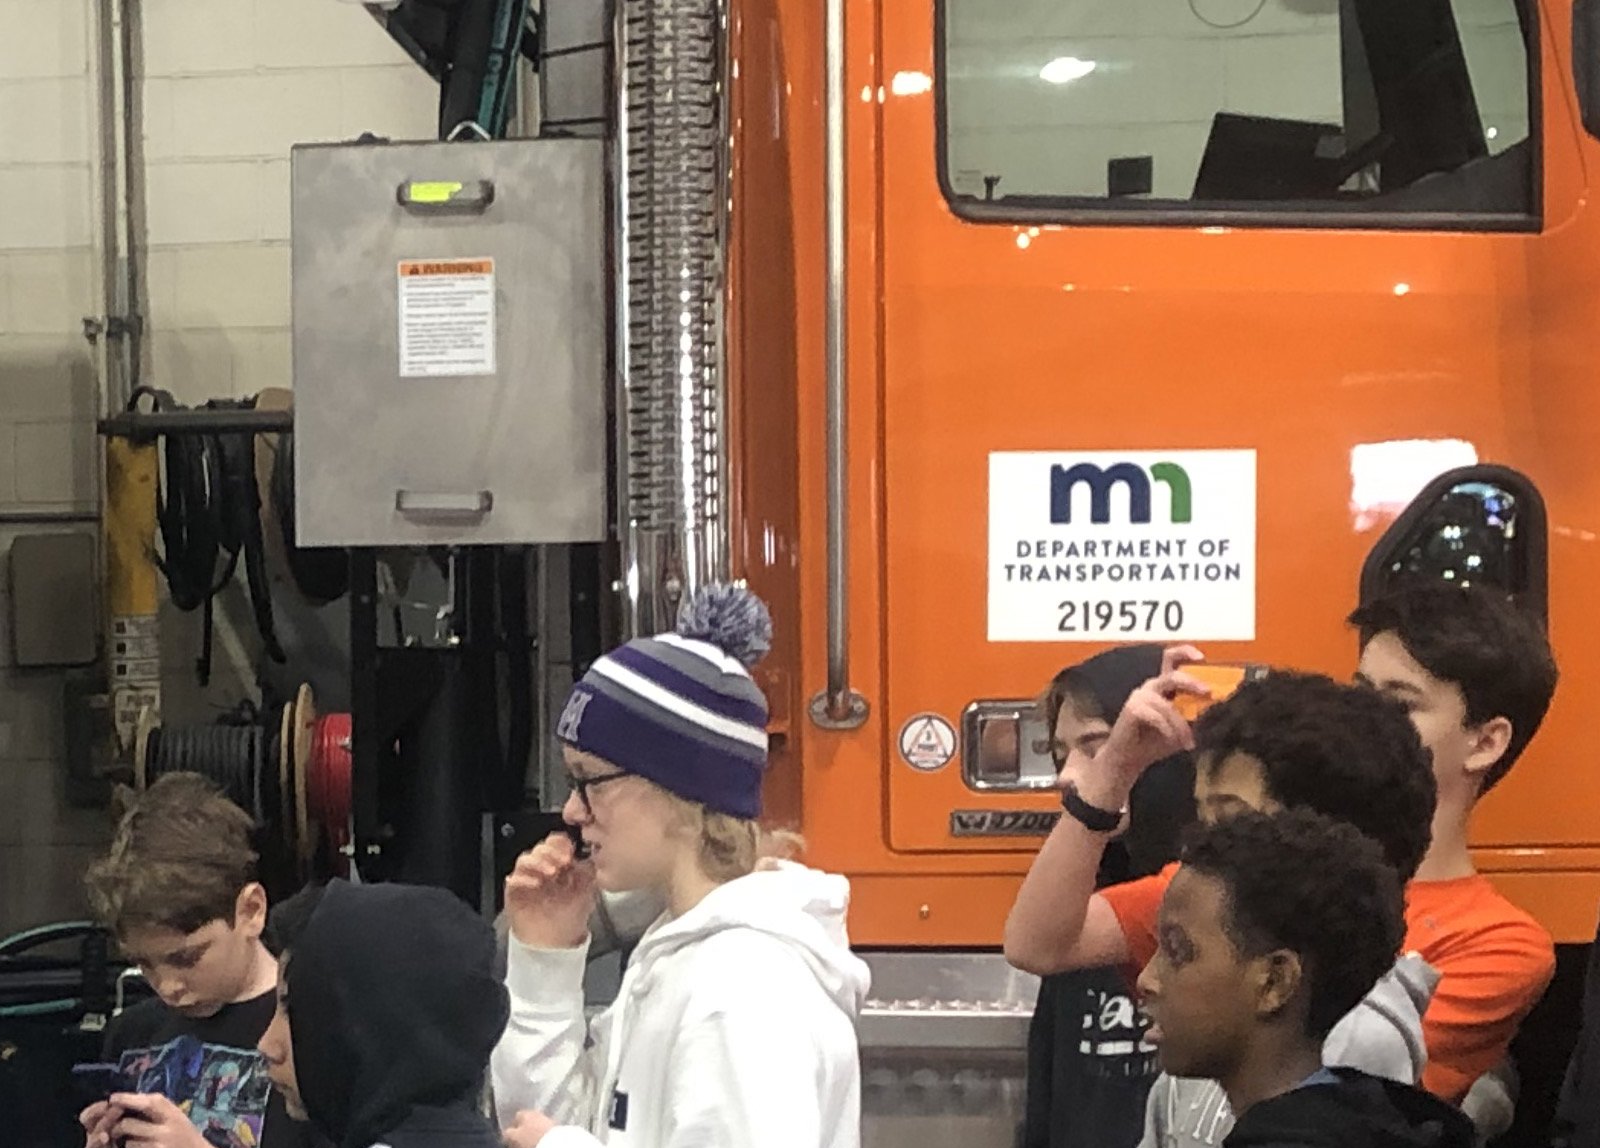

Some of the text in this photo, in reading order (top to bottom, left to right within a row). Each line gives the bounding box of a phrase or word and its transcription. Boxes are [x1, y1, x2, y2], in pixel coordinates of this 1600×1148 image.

[1016, 539, 1232, 559] DEPARTMENT OF
[1003, 563, 1242, 583] TRANSPORTATION
[1057, 600, 1185, 632] 219570
